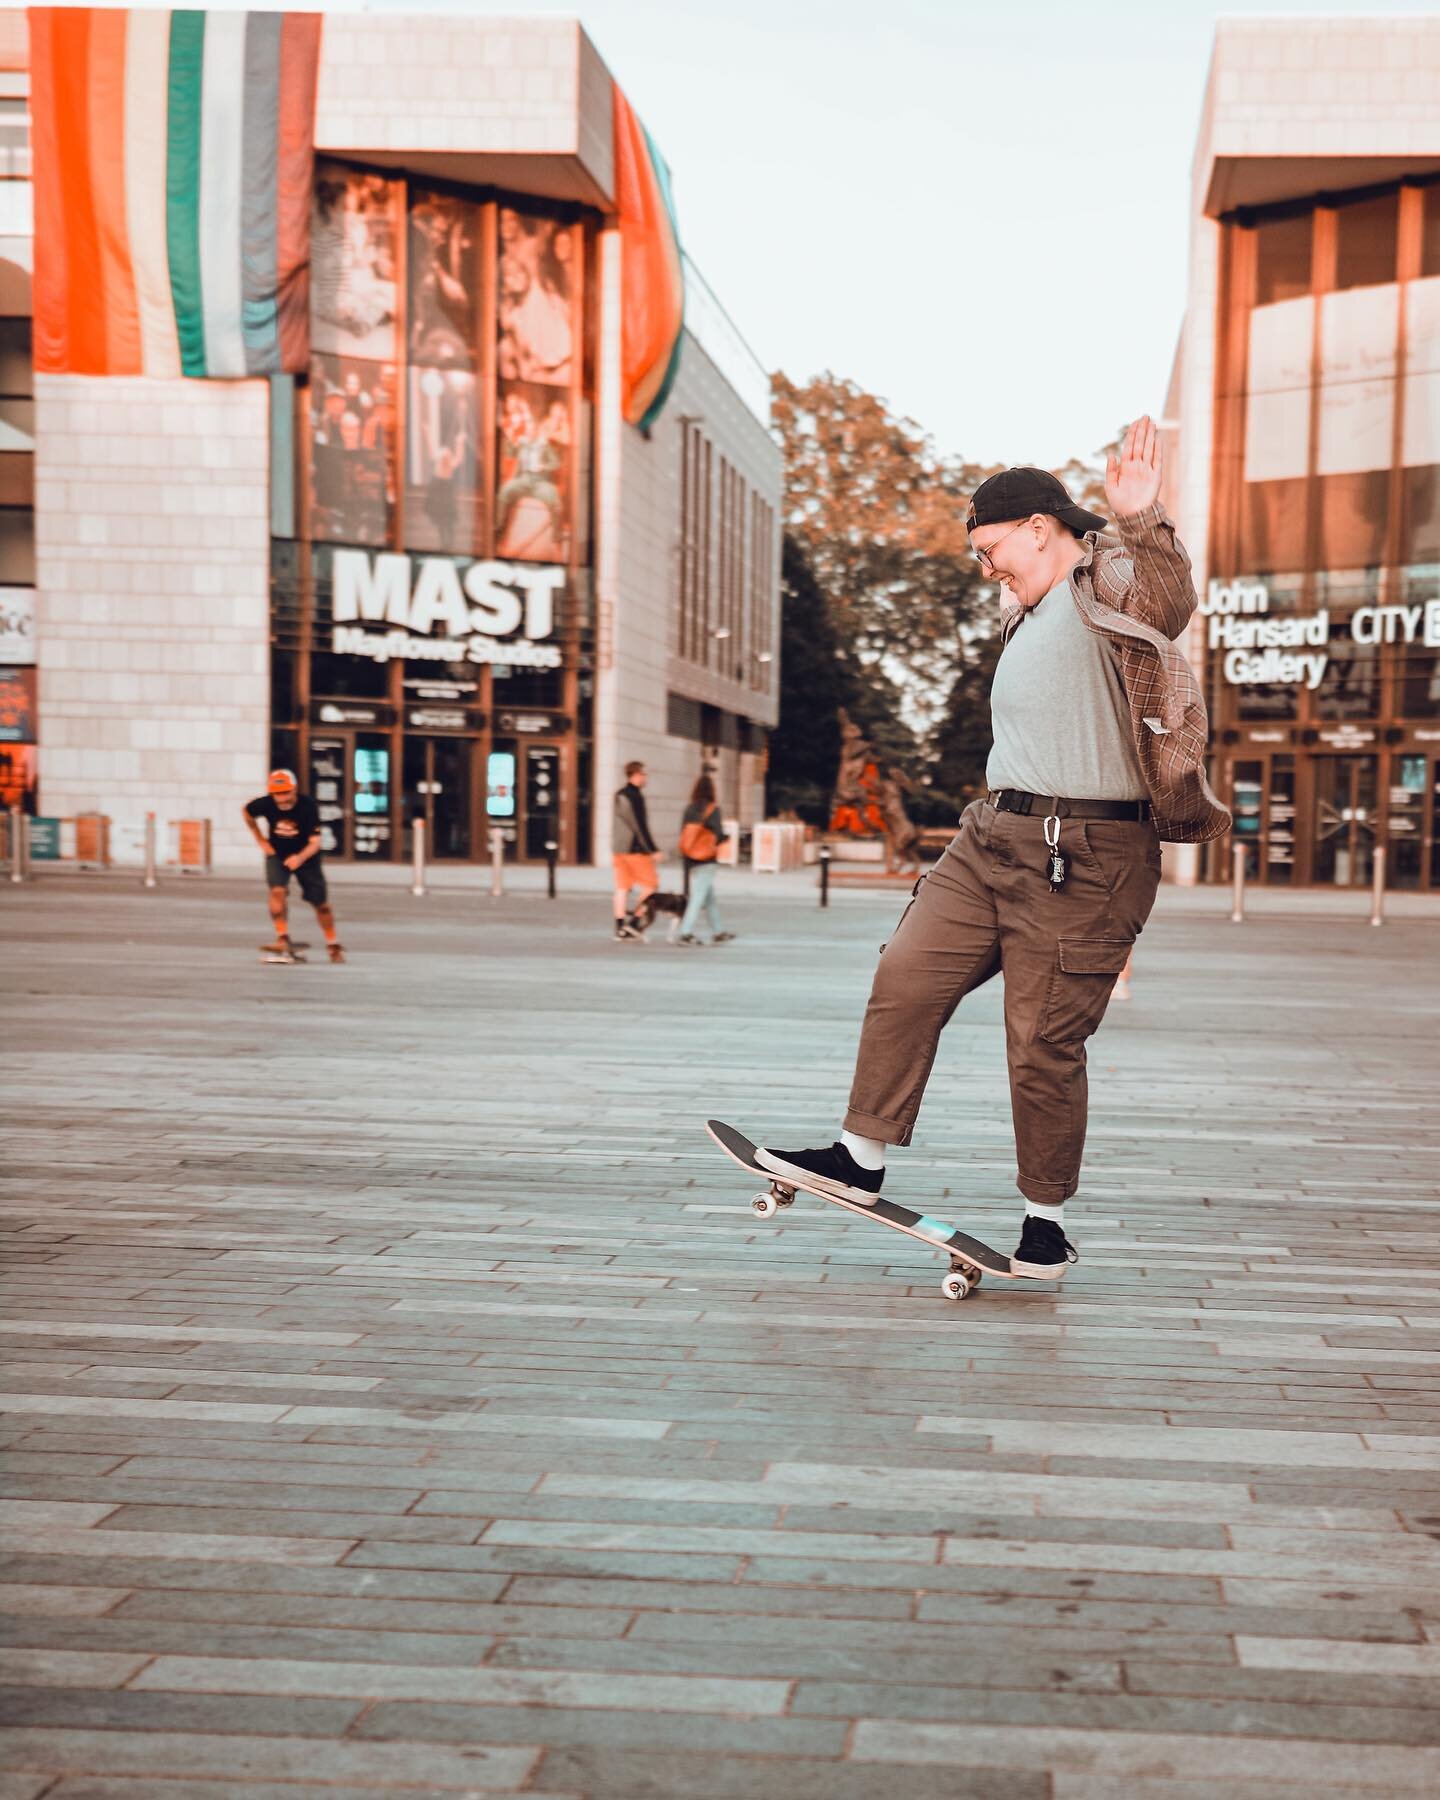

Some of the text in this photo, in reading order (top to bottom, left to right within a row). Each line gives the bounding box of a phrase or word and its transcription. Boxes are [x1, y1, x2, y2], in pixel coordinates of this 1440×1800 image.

[333, 551, 565, 640] MAST
[1200, 580, 1268, 615] John
[1208, 609, 1328, 650] Hansard
[1351, 605, 1422, 644] CITY
[333, 627, 562, 667] Mayflower Studios
[1224, 648, 1328, 690] Gallery
